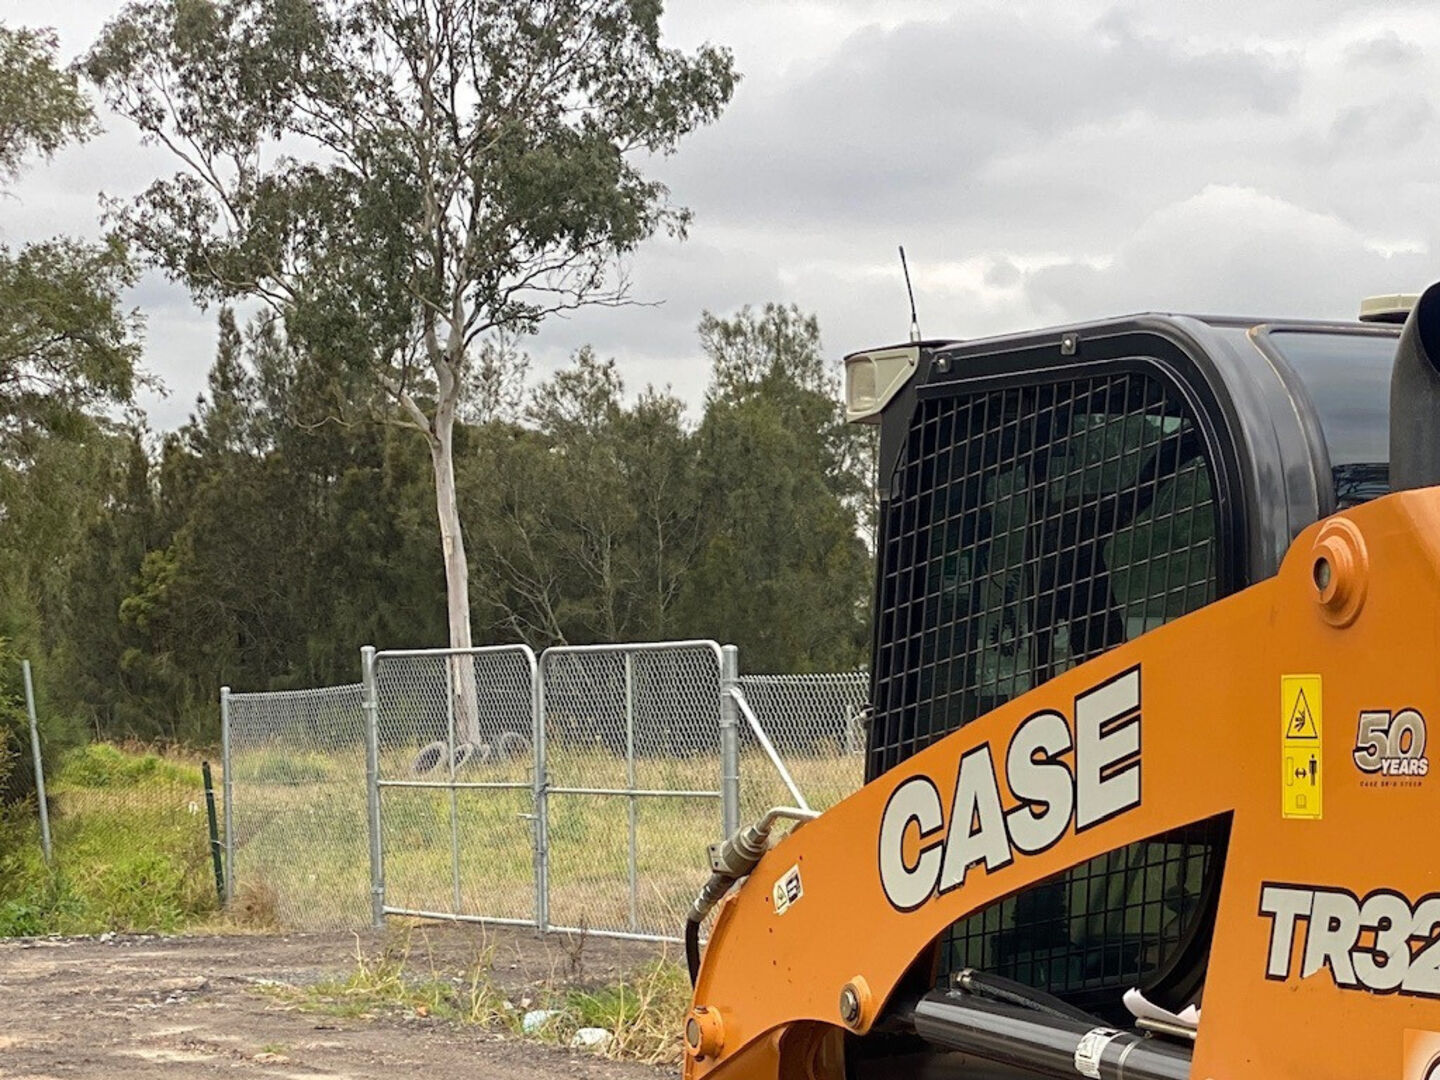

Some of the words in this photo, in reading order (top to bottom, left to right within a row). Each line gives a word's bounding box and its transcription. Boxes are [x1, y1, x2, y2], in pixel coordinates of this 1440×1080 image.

[1352, 707, 1428, 774] 50
[1381, 757, 1429, 776] YEARS
[879, 662, 1142, 913] CASE
